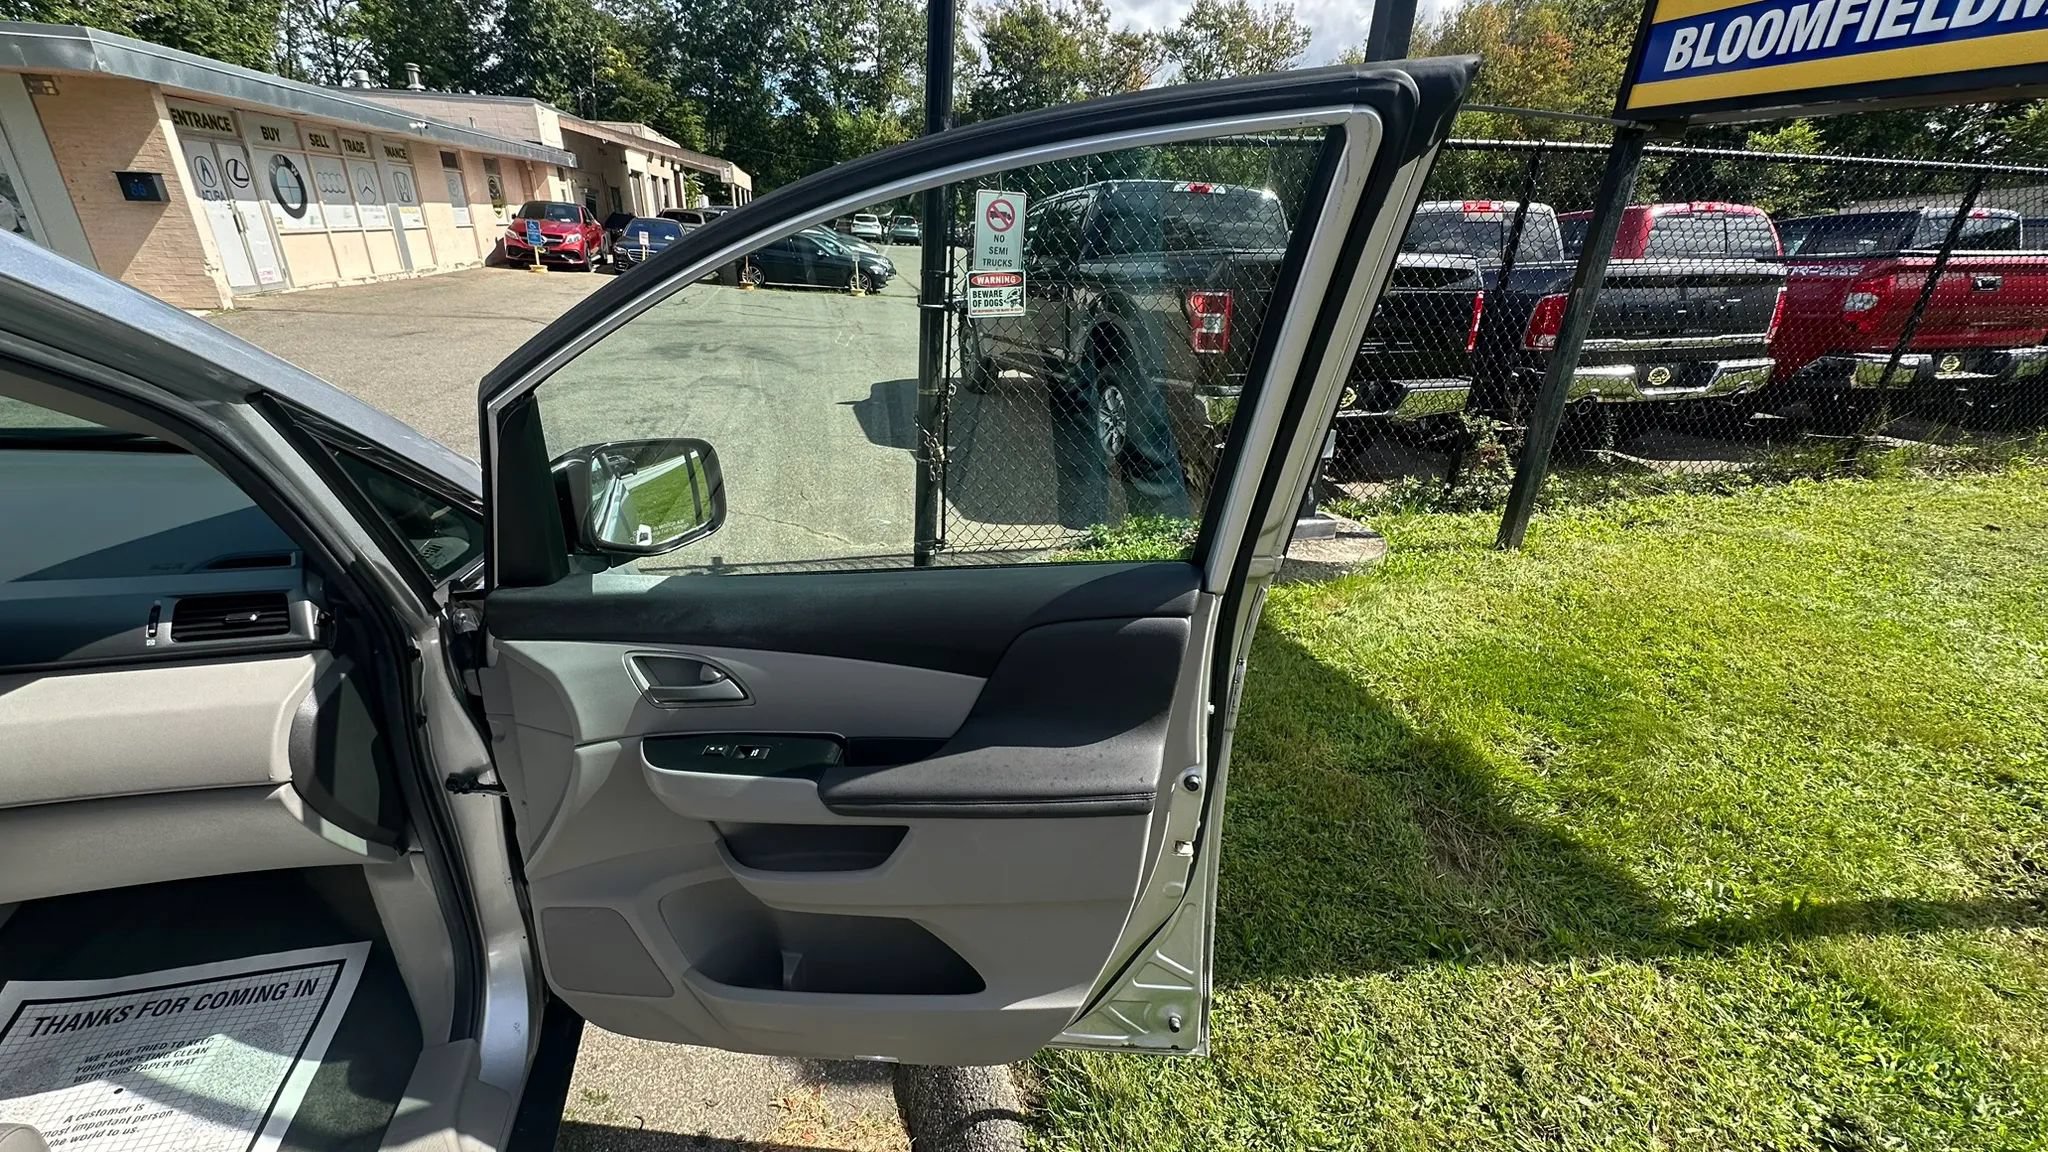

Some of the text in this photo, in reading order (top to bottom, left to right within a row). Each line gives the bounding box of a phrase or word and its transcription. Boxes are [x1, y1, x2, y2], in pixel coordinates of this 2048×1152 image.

[169, 108, 233, 132] ENTRANCE
[260, 126, 281, 141] BUY
[309, 133, 330, 149] SELL
[342, 138, 366, 154] TRADE
[993, 234, 1005, 243] NO
[988, 246, 1008, 255] SEMI
[982, 258, 1013, 267] TRUCKS
[976, 275, 1016, 284] WARNING
[972, 290, 1003, 298] BEWARE
[972, 299, 1003, 308] OF DOGS
[30, 978, 320, 1037] THANKS FOR COMING IN
[84, 1037, 214, 1064] WE HAVE TRIED TO KEEP
[76, 1046, 209, 1073] YOUR CARPETING CLEAN
[73, 1057, 197, 1083] WITH THIS PAPER MAT
[63, 1114, 73, 1124] A
[75, 1105, 132, 1122] customer
[41, 1110, 174, 1138] most important person
[70, 1129, 104, 1143] world
[107, 1128, 120, 1137] to
[122, 1124, 140, 1136] us.
